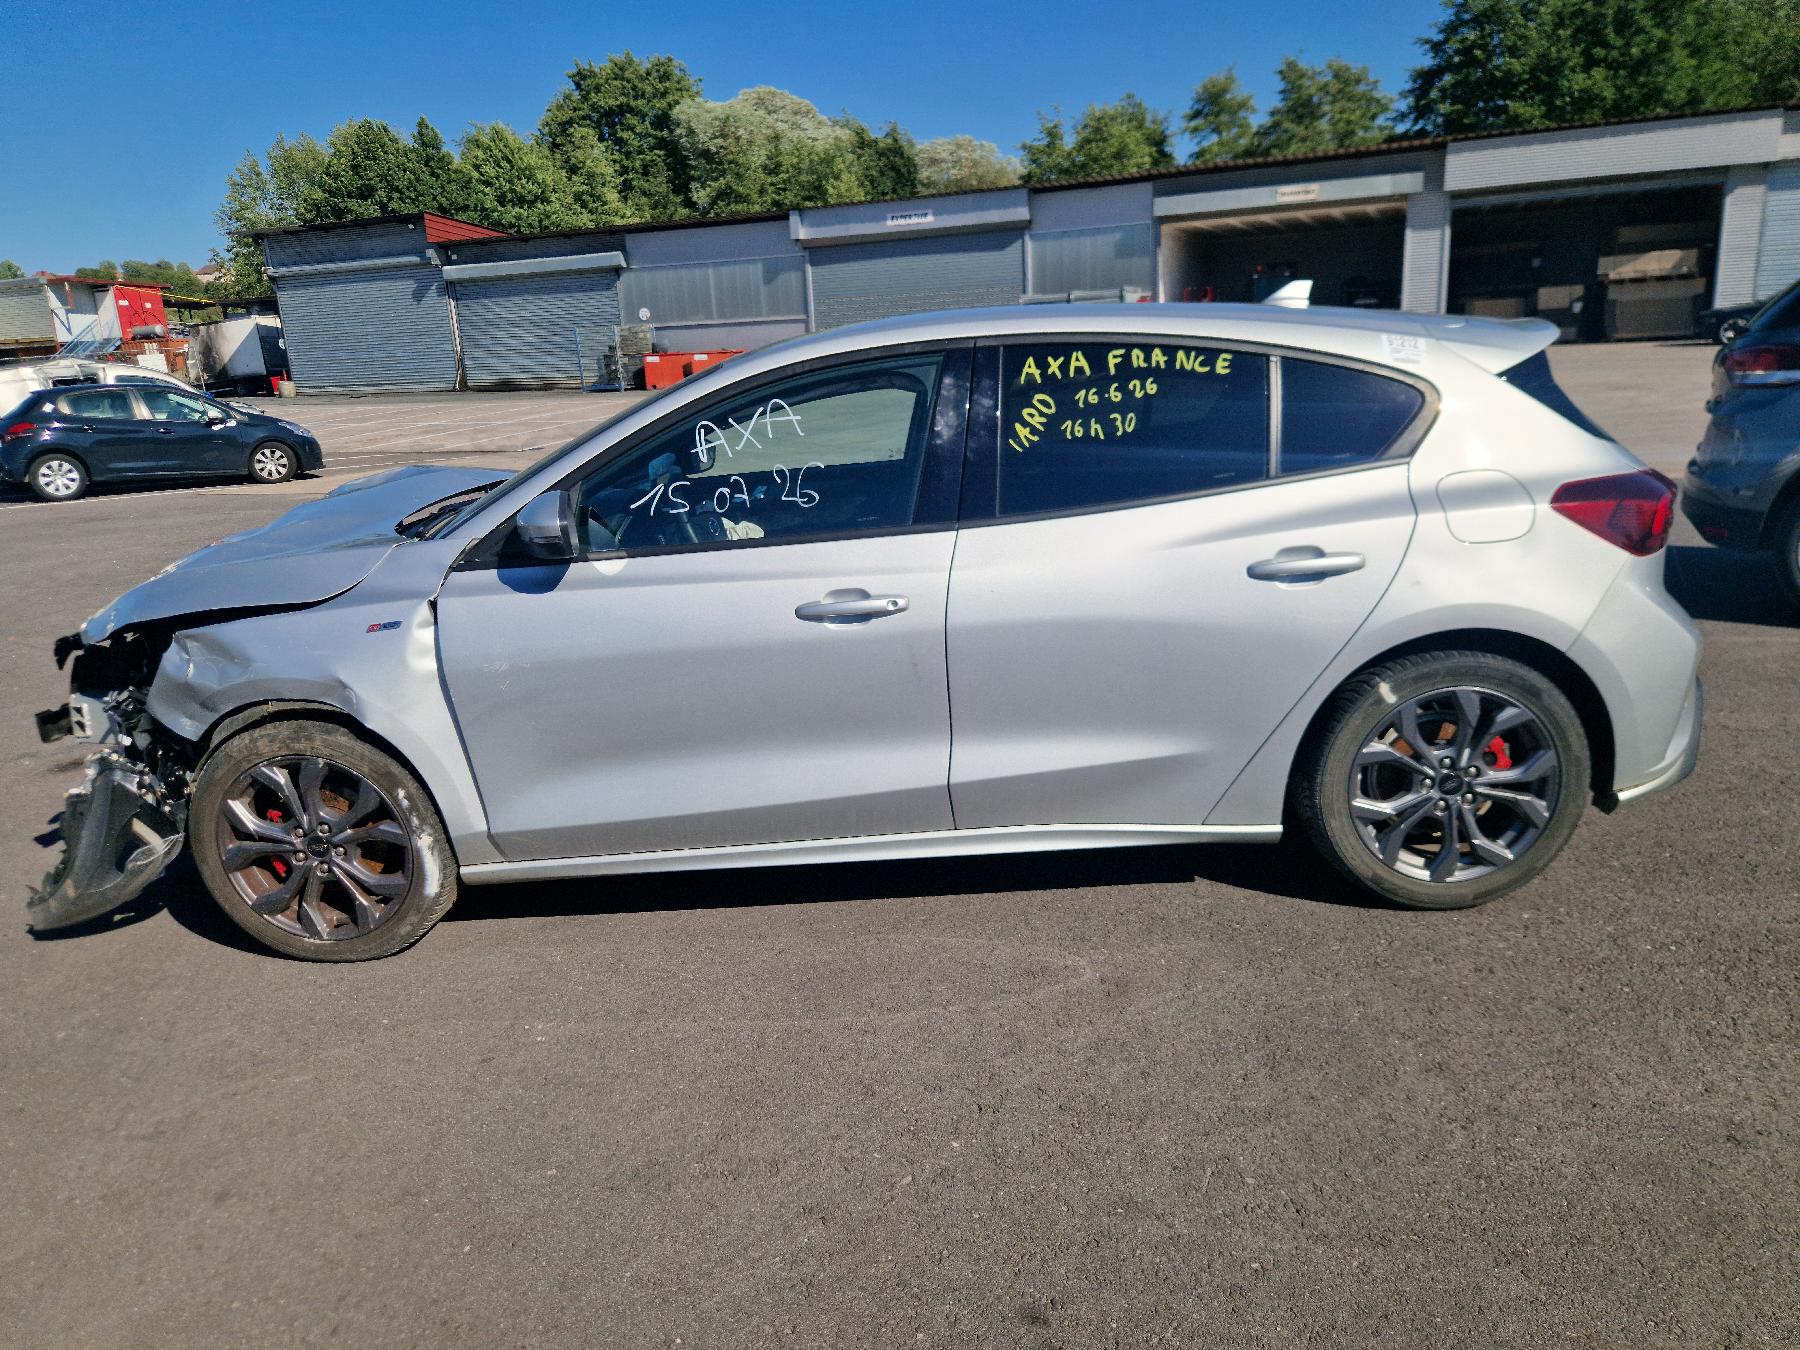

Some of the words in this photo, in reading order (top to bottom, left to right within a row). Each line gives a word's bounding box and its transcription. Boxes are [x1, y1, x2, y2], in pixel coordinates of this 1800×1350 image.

[1020, 351, 1091, 384] AXA
[1107, 348, 1234, 375] FRANCE
[690, 398, 805, 463] AXA
